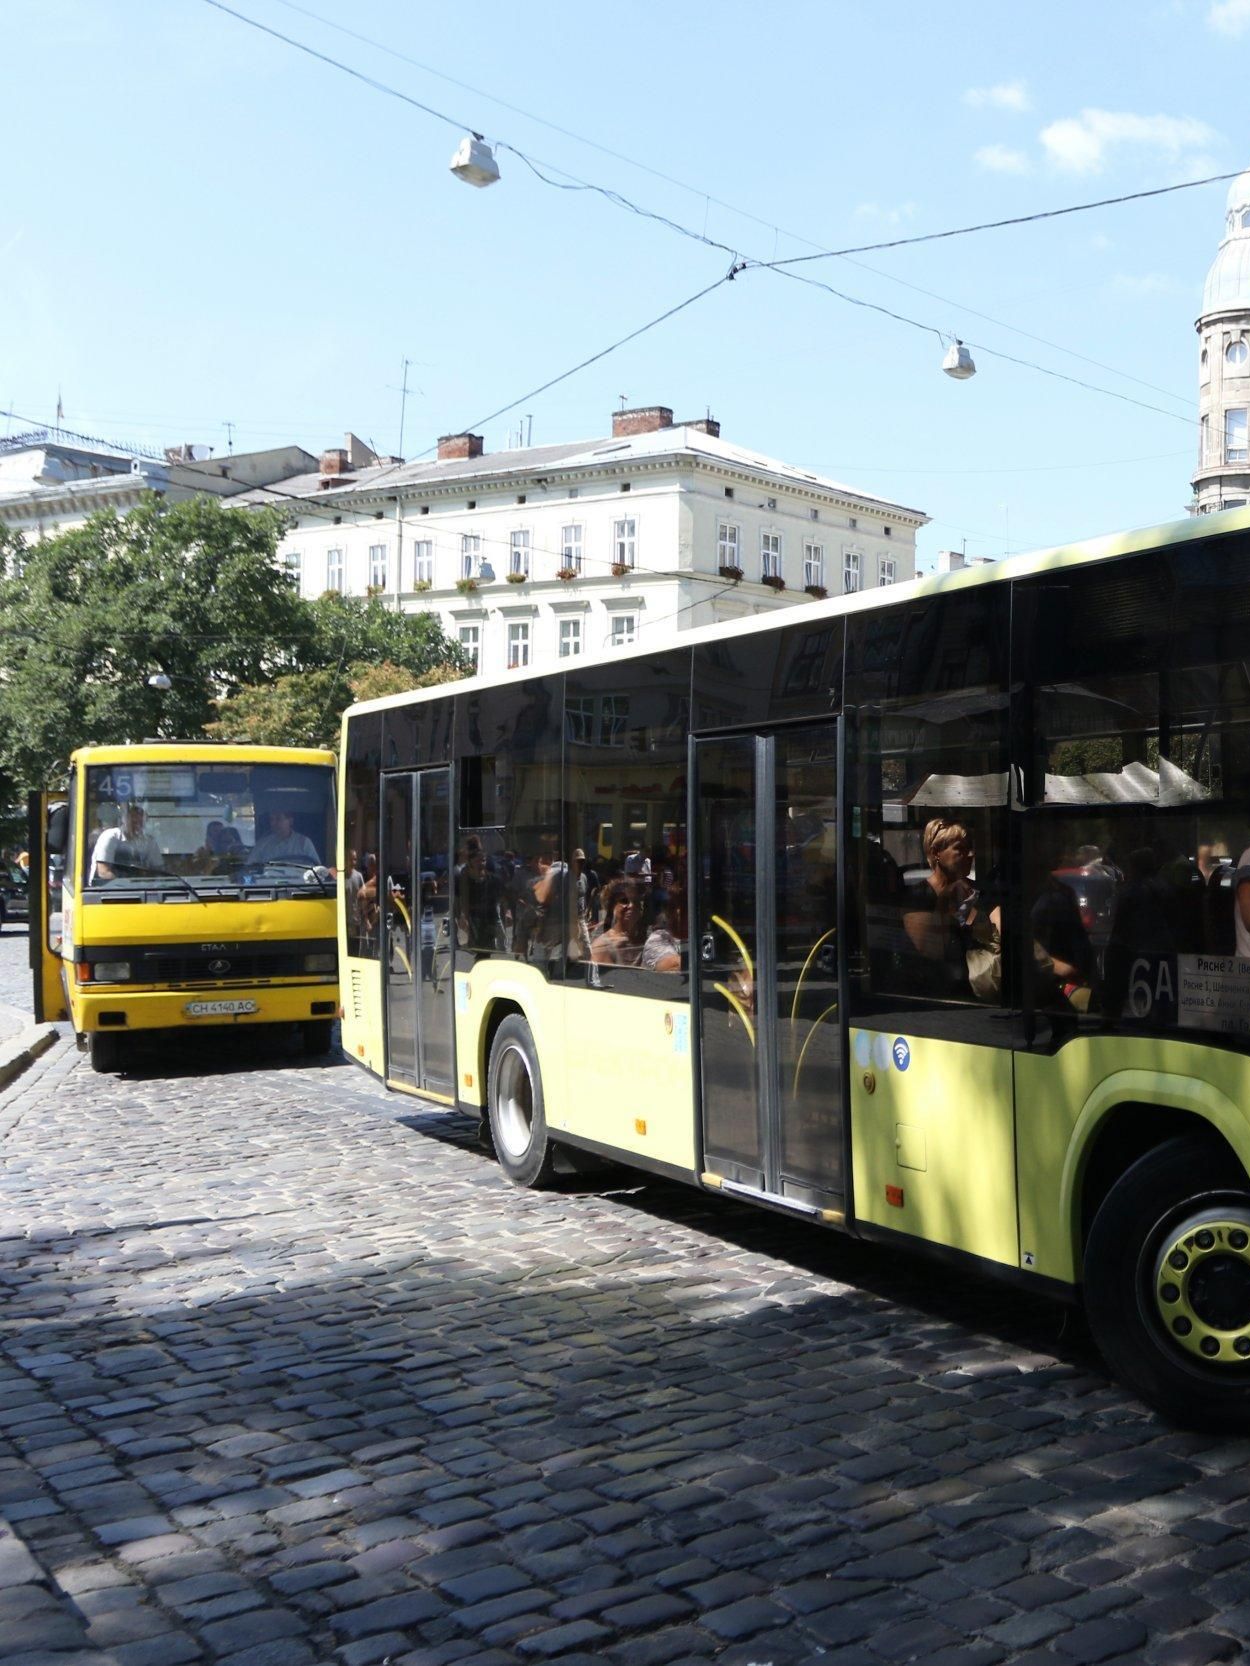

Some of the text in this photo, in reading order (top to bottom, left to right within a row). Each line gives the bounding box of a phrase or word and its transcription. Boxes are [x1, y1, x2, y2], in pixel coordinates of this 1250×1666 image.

[98, 775, 132, 796] 45
[1197, 958, 1225, 972] Рясне
[1228, 960, 1234, 972] 2
[1128, 958, 1174, 1018] 6А
[210, 1002, 235, 1013] 4140
